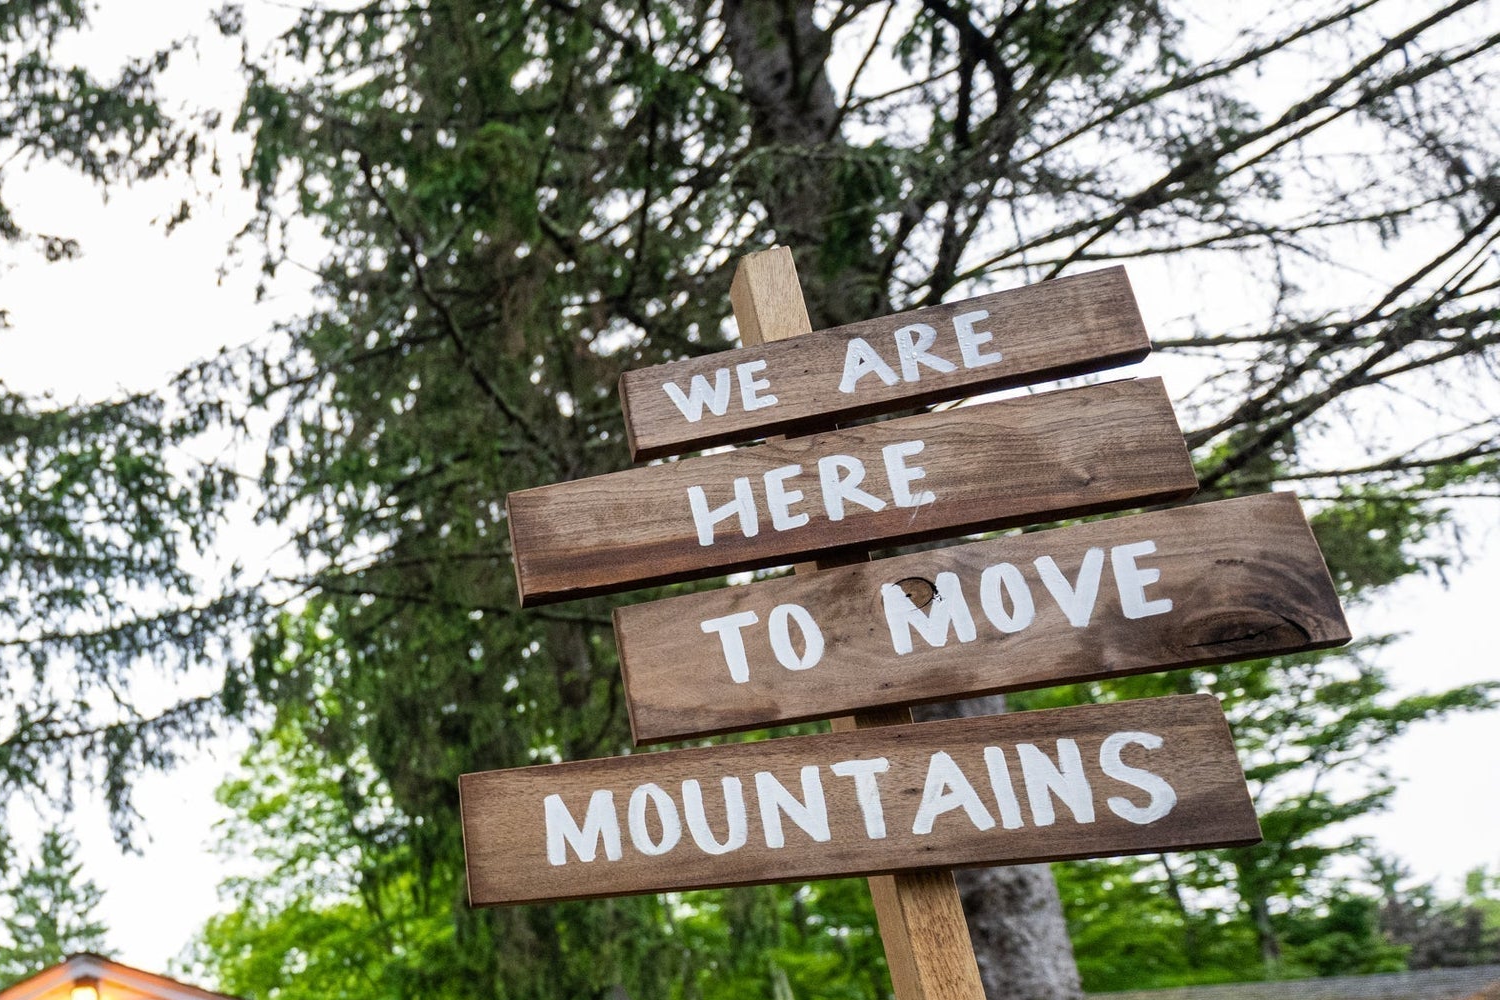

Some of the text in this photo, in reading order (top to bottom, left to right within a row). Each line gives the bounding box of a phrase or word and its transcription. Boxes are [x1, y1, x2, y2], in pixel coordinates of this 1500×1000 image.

[662, 310, 1003, 423] WE ARE
[686, 440, 936, 545] HERE
[700, 539, 1173, 684] TO MOVE
[544, 731, 1178, 866] MOUNTAINS
